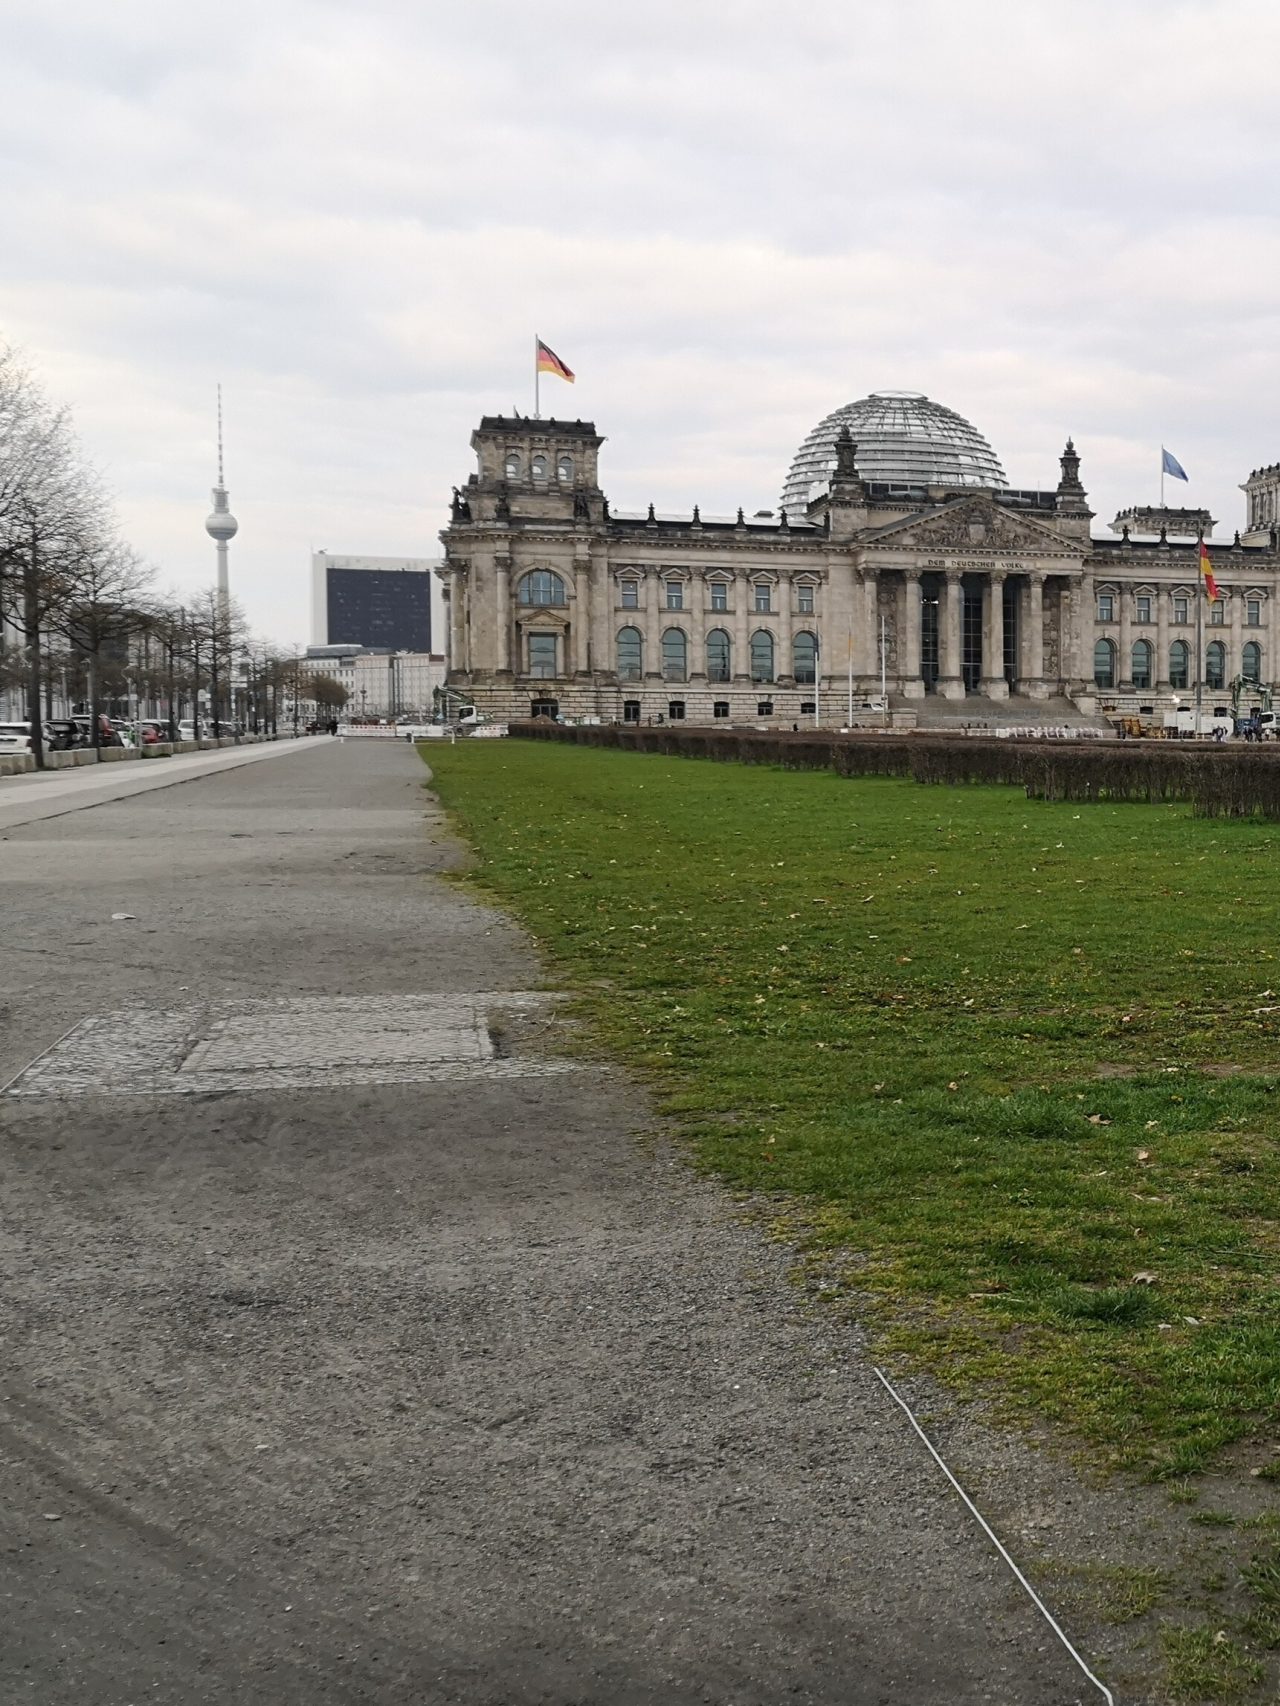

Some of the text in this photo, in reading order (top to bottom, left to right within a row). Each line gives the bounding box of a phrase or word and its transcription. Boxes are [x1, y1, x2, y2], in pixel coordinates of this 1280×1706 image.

[928, 559, 1024, 569] DEM DEUTSCHEN VOLKE
